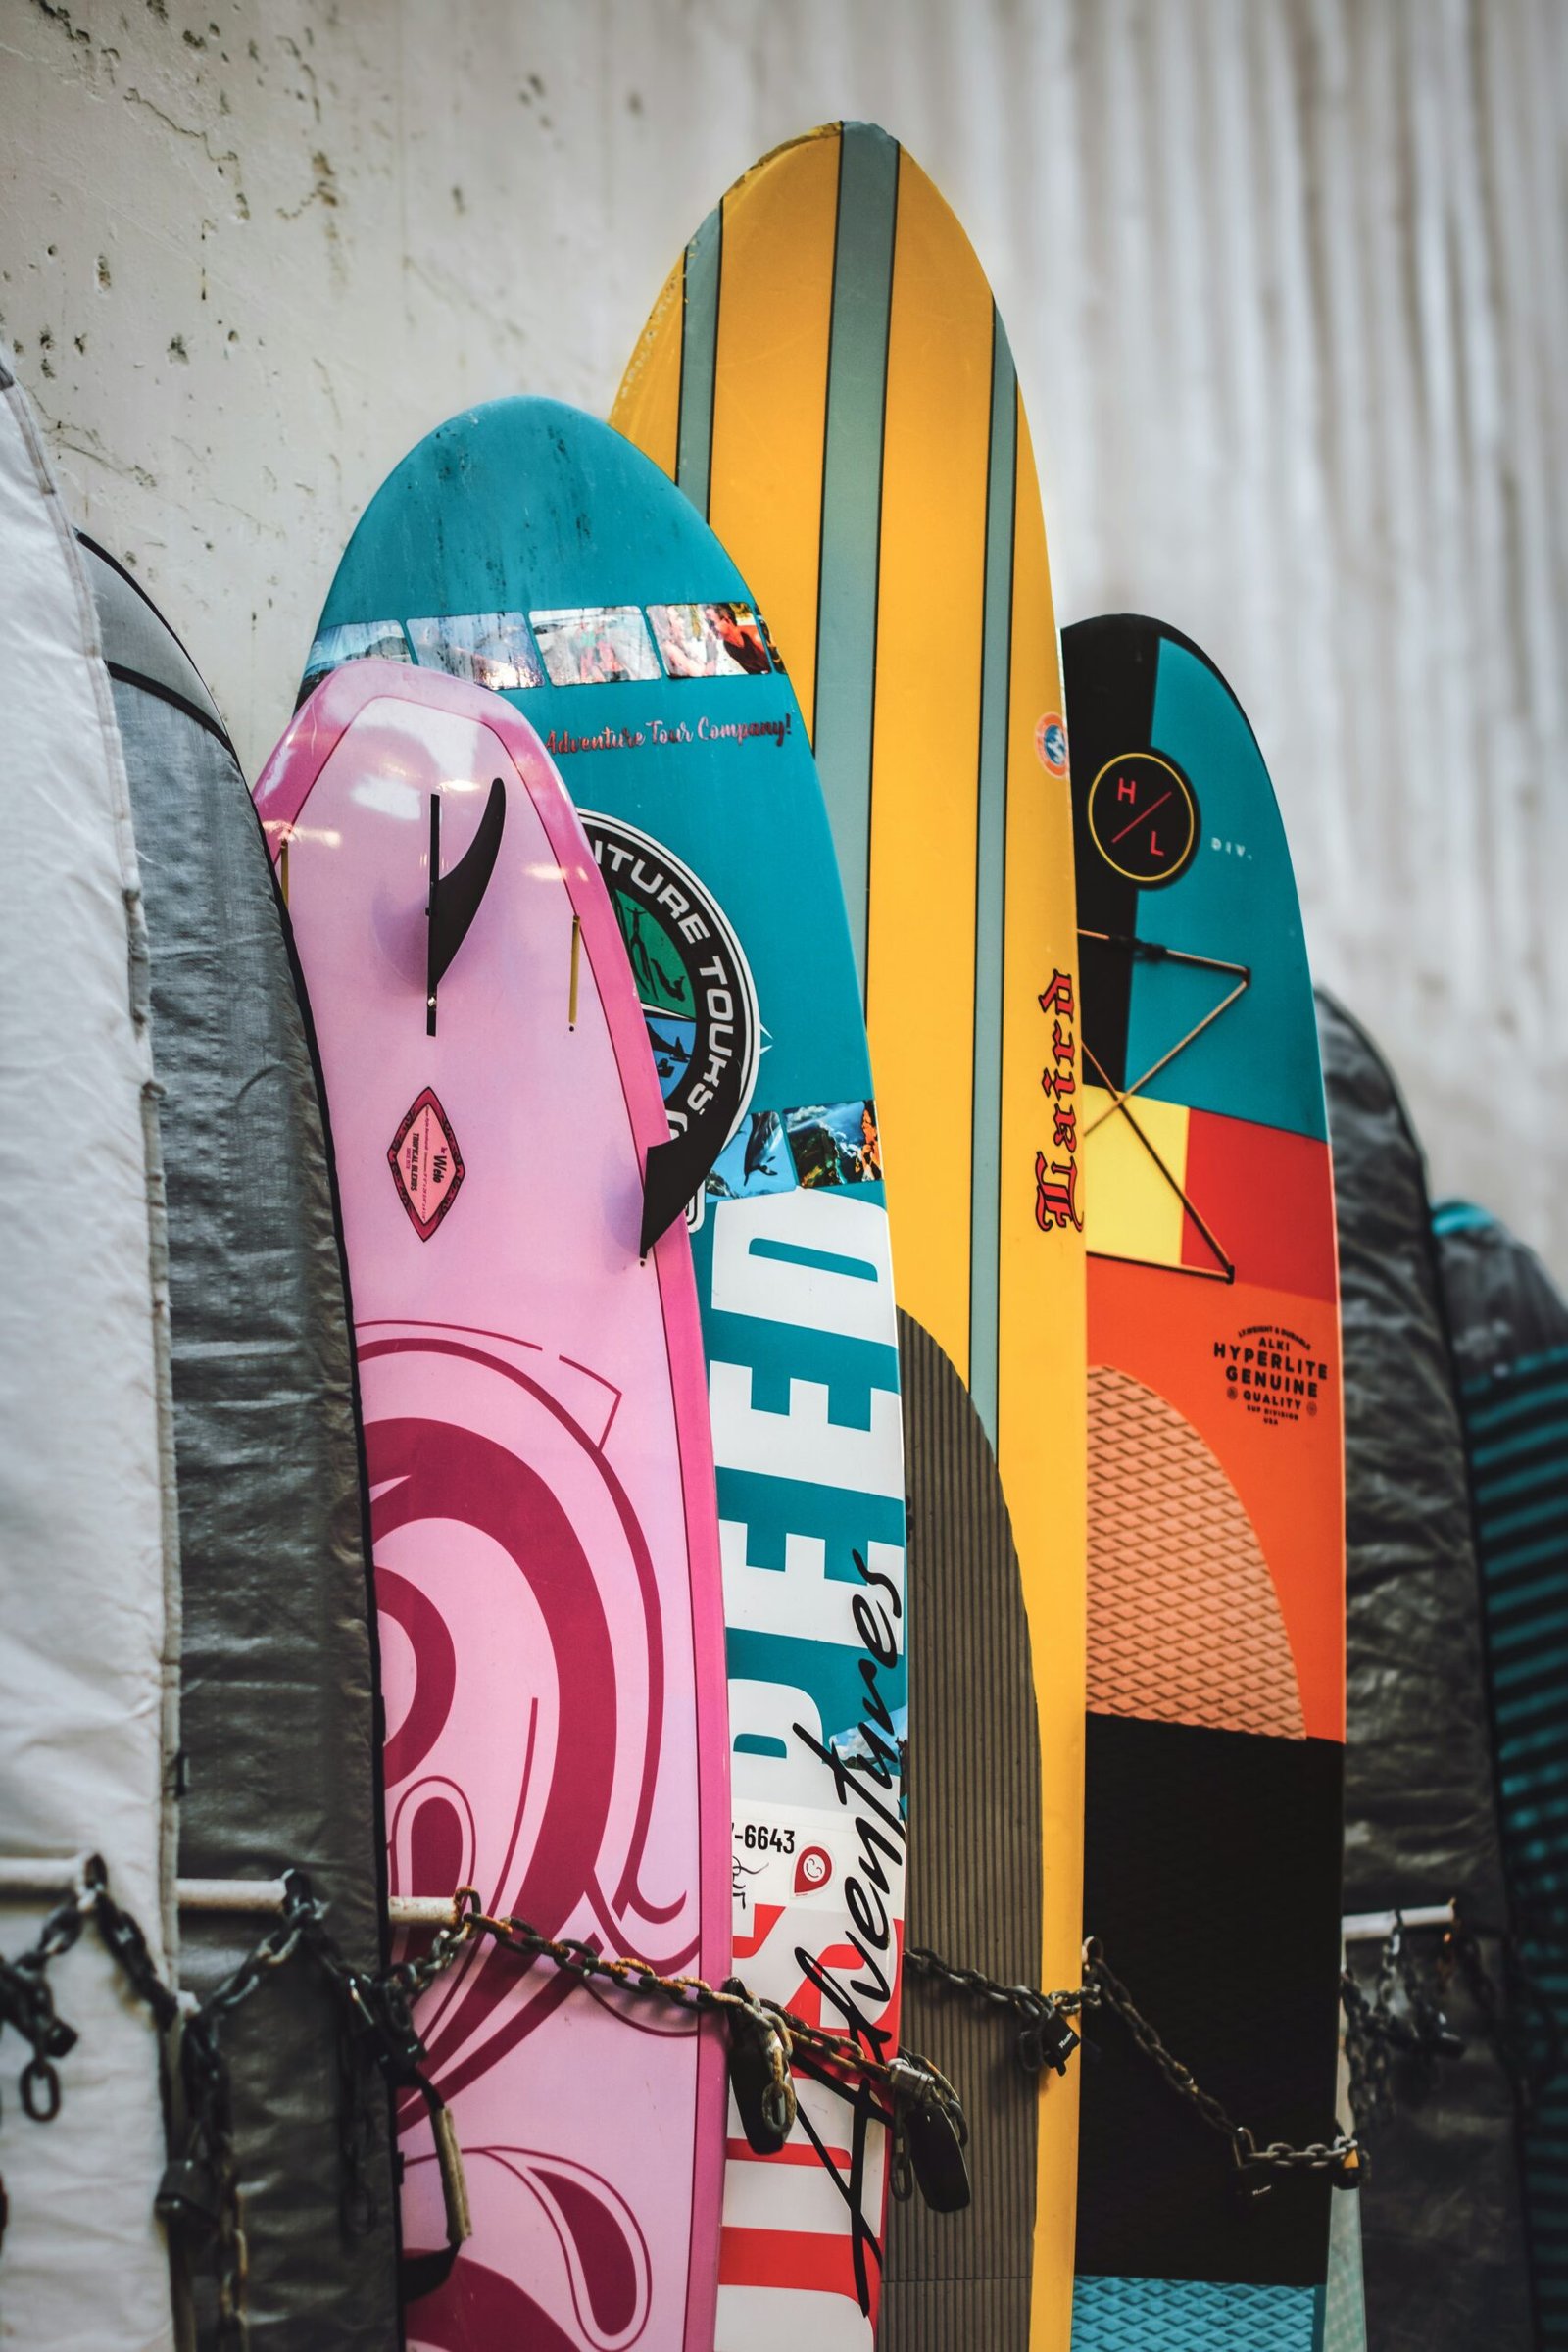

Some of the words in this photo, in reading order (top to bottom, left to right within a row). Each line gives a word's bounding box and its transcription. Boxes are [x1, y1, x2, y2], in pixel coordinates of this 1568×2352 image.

[545, 728, 646, 756] Adventure
[645, 720, 695, 746] Tour
[697, 712, 793, 747] Company!
[1210, 836, 1253, 861] DIV.
[1035, 968, 1084, 1233] Laird
[1258, 1336, 1291, 1352] ALKI
[1213, 1342, 1328, 1380] HYPERLITE
[1225, 1365, 1318, 1399] GENUINE
[1243, 1390, 1301, 1411] QUALITY
[731, 1822, 795, 1854] -6643
